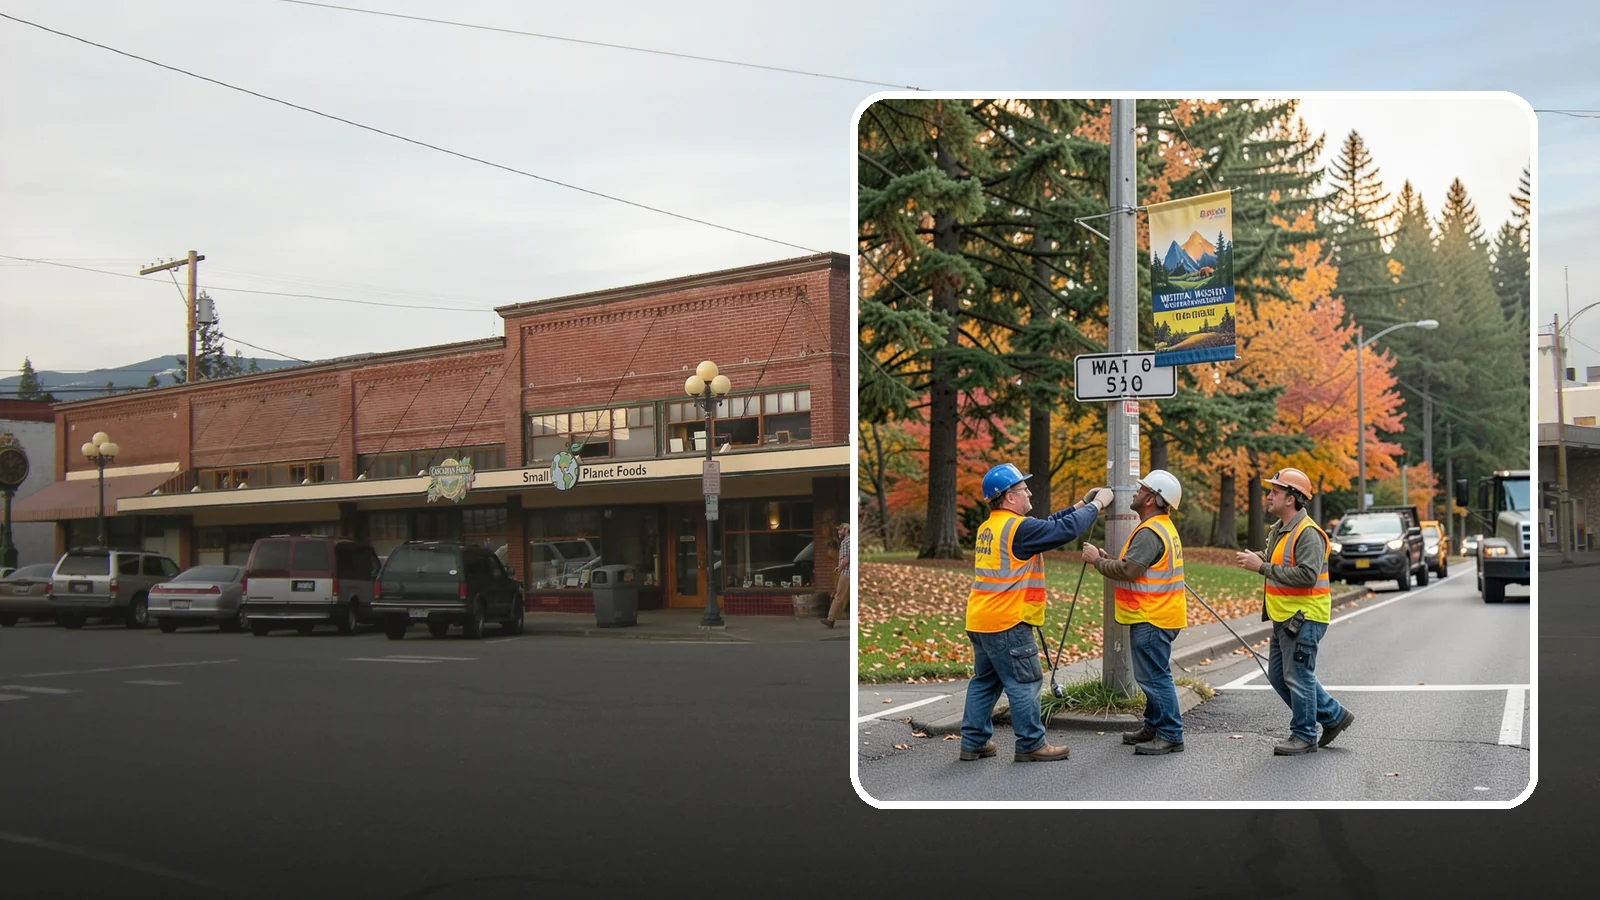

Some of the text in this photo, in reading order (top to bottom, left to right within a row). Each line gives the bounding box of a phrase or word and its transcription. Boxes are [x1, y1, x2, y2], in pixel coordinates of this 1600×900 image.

[523, 464, 647, 483] Small Planet Foods
